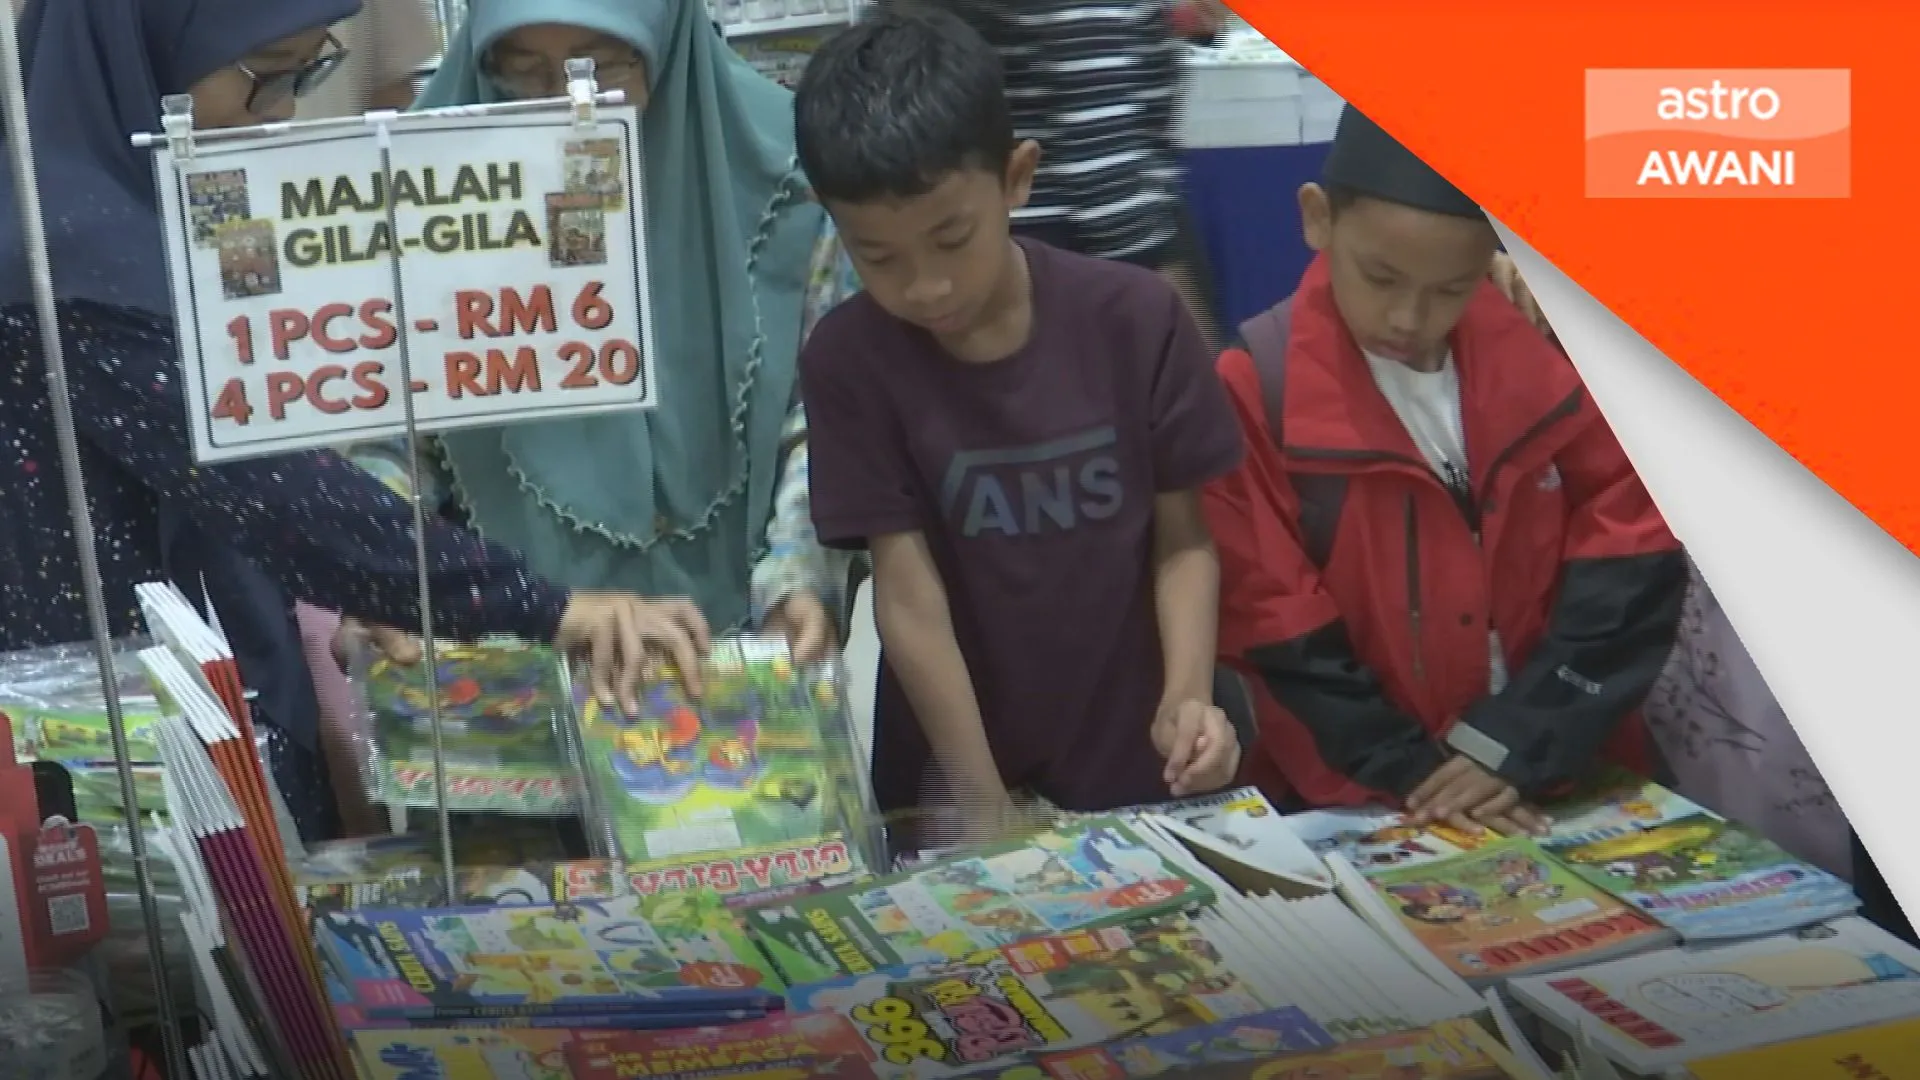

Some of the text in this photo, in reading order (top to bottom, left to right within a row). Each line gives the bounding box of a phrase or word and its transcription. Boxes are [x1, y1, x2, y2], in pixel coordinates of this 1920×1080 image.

[280, 161, 522, 220] MAJALAH
[284, 209, 541, 268] GILA-GILA
[227, 315, 254, 364] 1
[269, 299, 397, 360] PCS
[455, 283, 556, 340] RM
[571, 281, 613, 331] 6
[210, 377, 254, 426] 4
[265, 360, 390, 420] PCS
[444, 345, 541, 399] RM
[558, 338, 640, 390] 20
[631, 840, 852, 897] GILA-GILA
